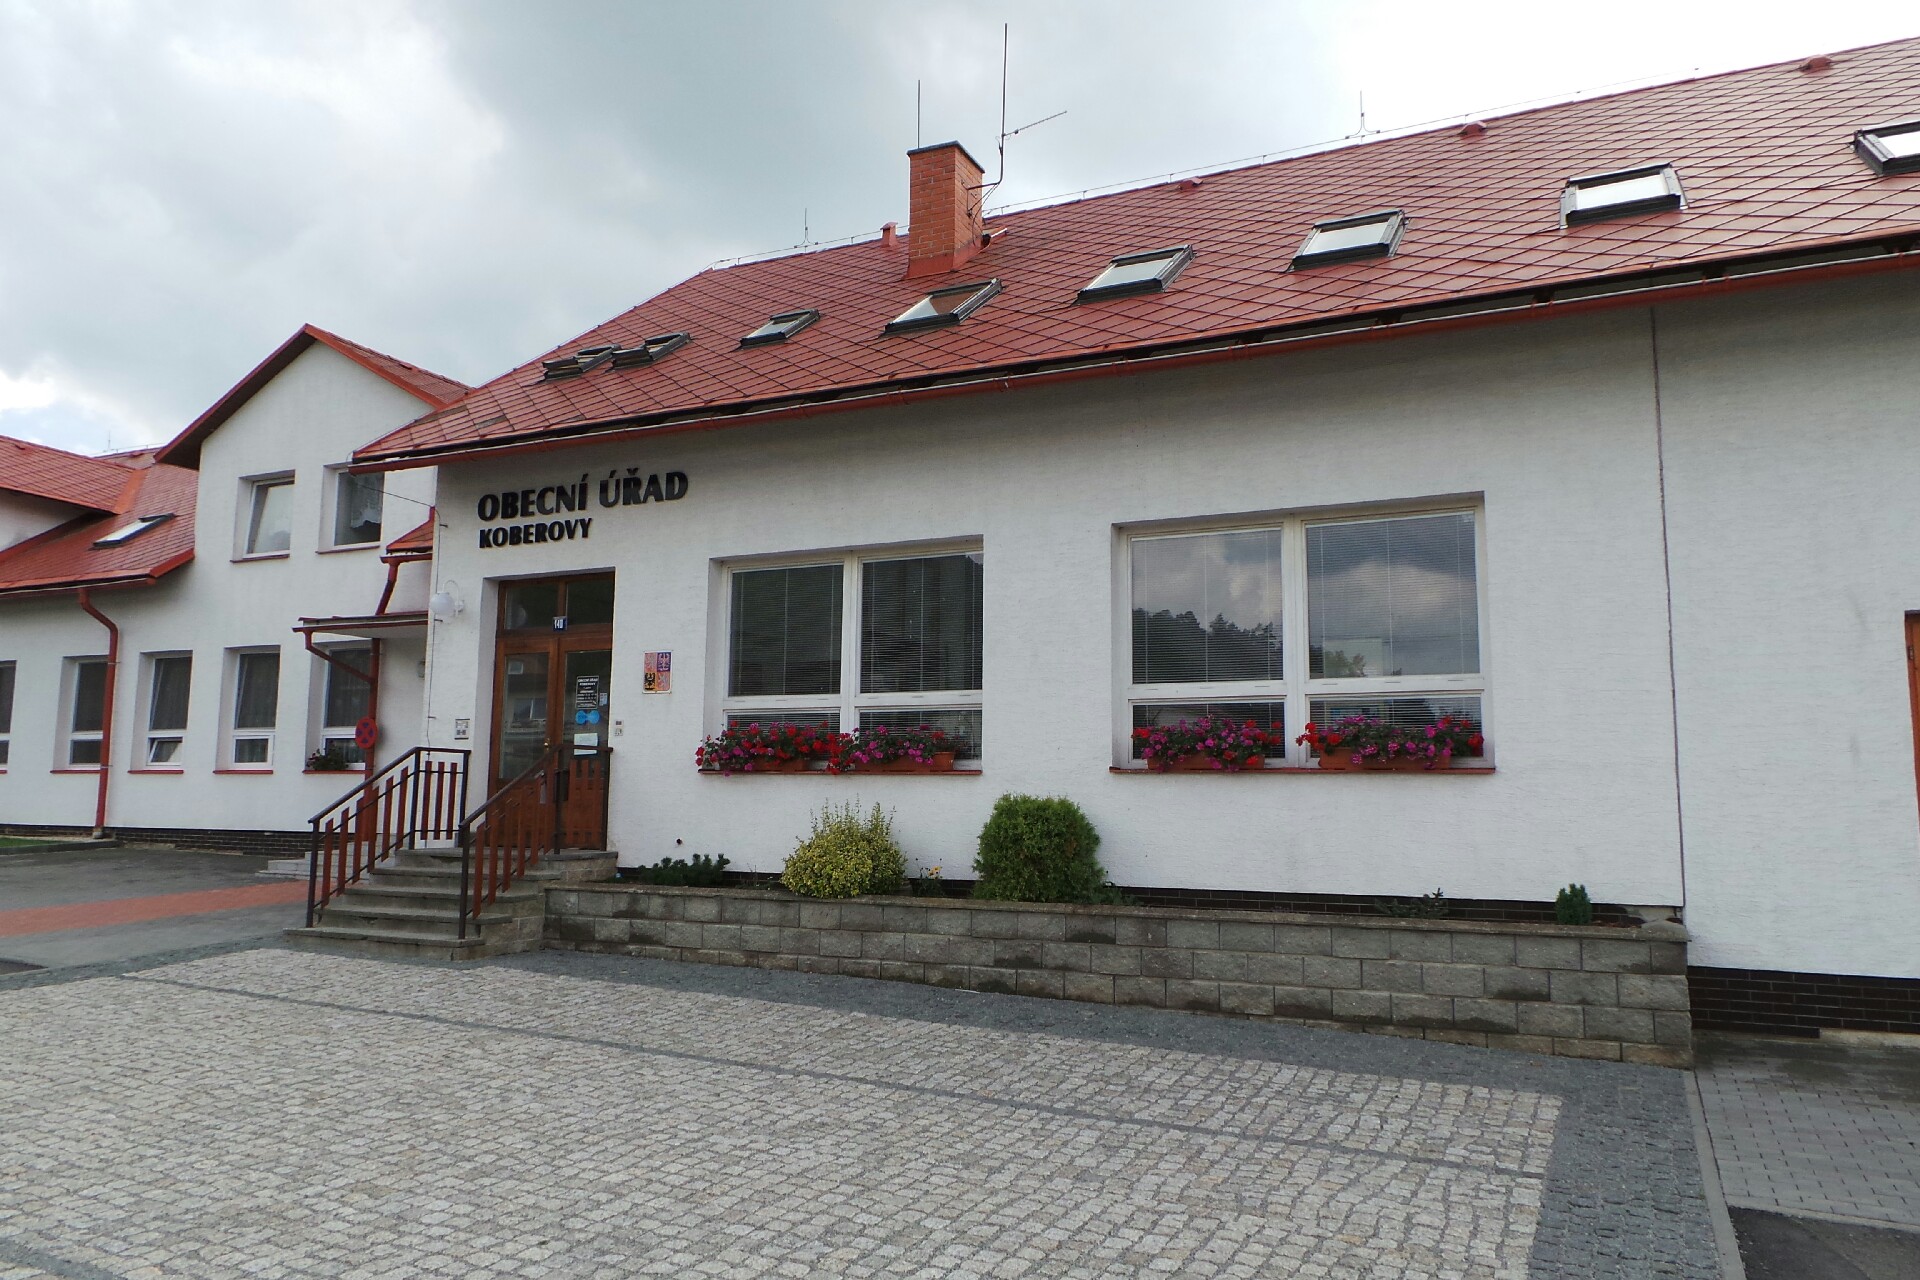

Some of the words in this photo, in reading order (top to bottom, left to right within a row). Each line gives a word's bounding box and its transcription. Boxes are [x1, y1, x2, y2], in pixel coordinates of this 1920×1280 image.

[478, 473, 589, 521] OBECNÍ
[599, 467, 689, 508] ÚŘAD
[479, 518, 593, 548] KOBEROVY
